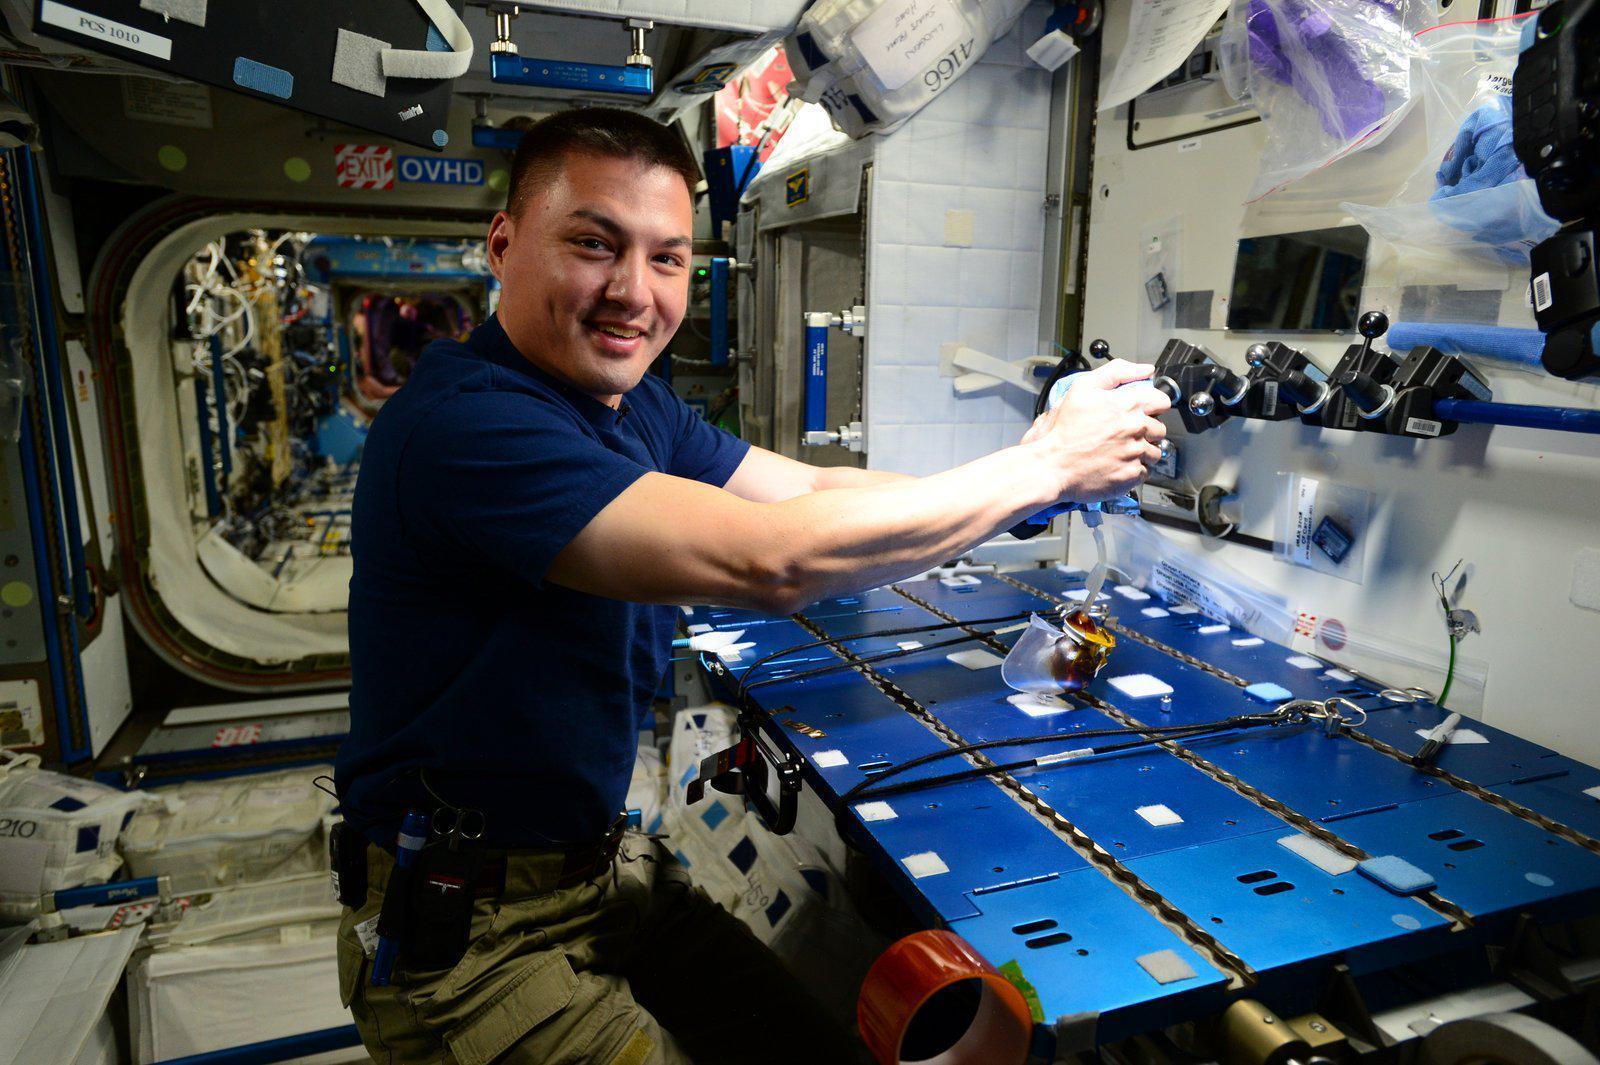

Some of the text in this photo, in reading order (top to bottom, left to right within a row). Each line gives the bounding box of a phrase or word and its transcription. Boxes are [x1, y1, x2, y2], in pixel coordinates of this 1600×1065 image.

[80, 17, 140, 44] PCS 1010
[924, 37, 975, 92] 4166
[344, 155, 386, 178] EXIT
[401, 158, 482, 183] OVHD
